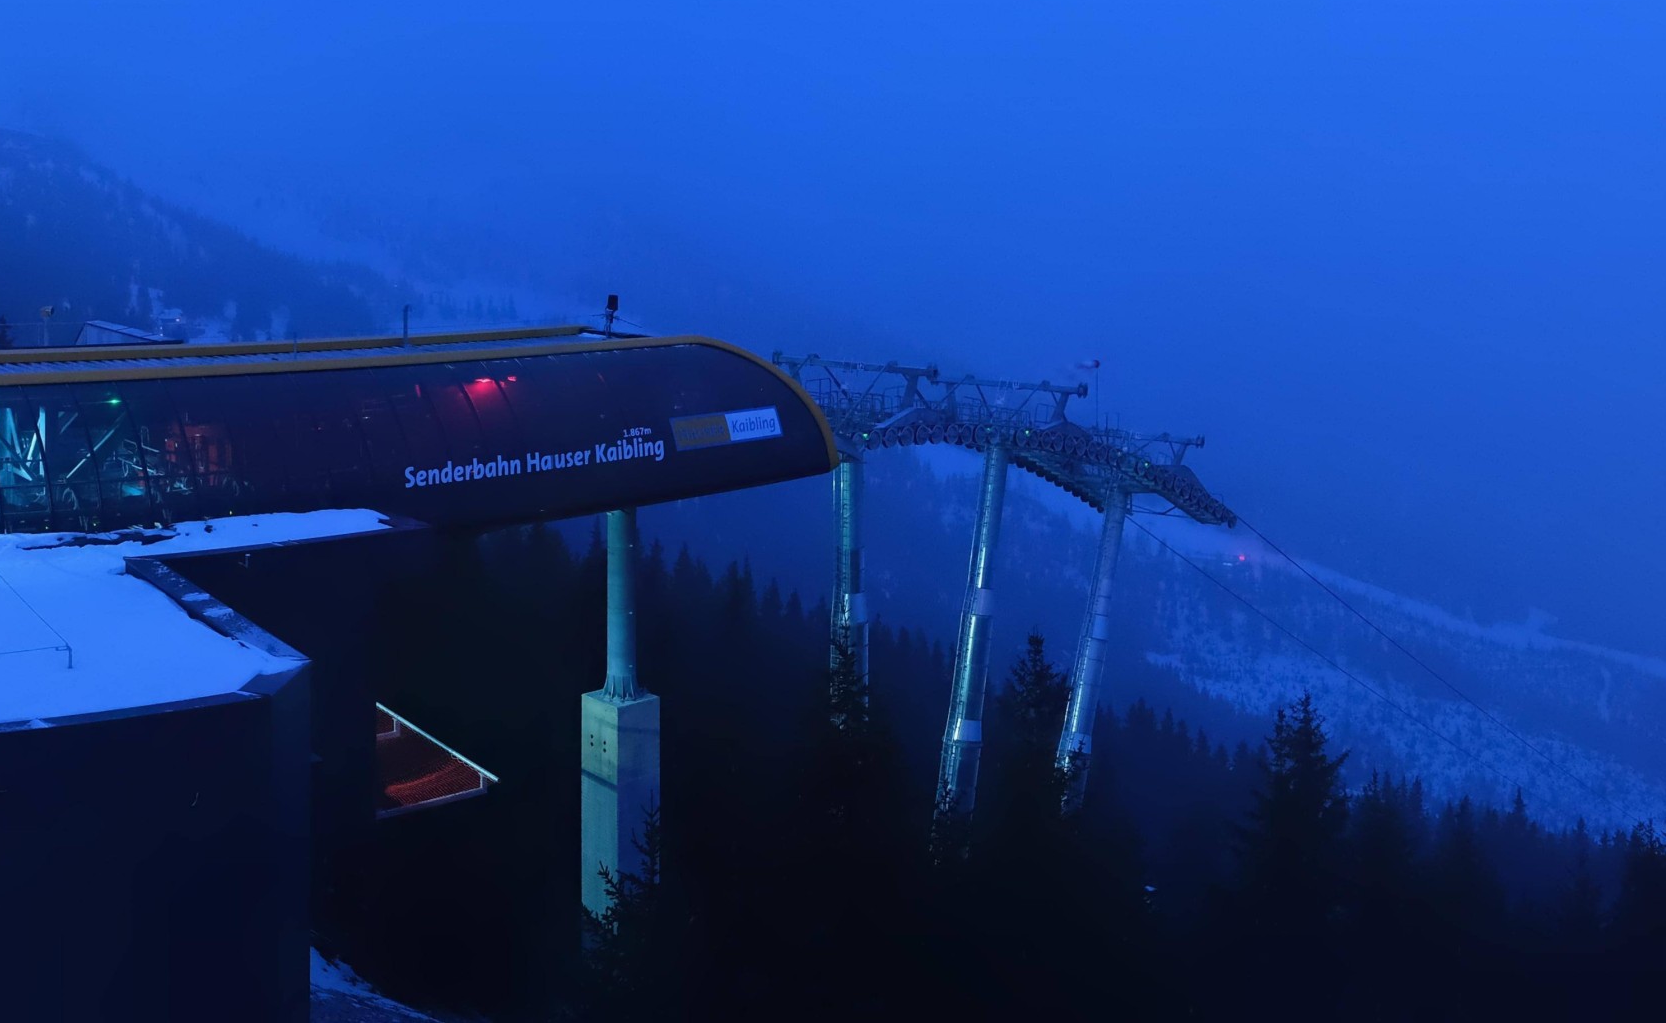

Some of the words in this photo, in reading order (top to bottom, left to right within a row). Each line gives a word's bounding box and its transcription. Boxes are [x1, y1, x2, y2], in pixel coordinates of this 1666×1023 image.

[623, 426, 652, 438] 1.867m
[731, 416, 776, 434] Kaibling
[404, 455, 521, 489] Senderbahn
[527, 449, 591, 473] Hauser
[594, 436, 665, 464] Kaibling
